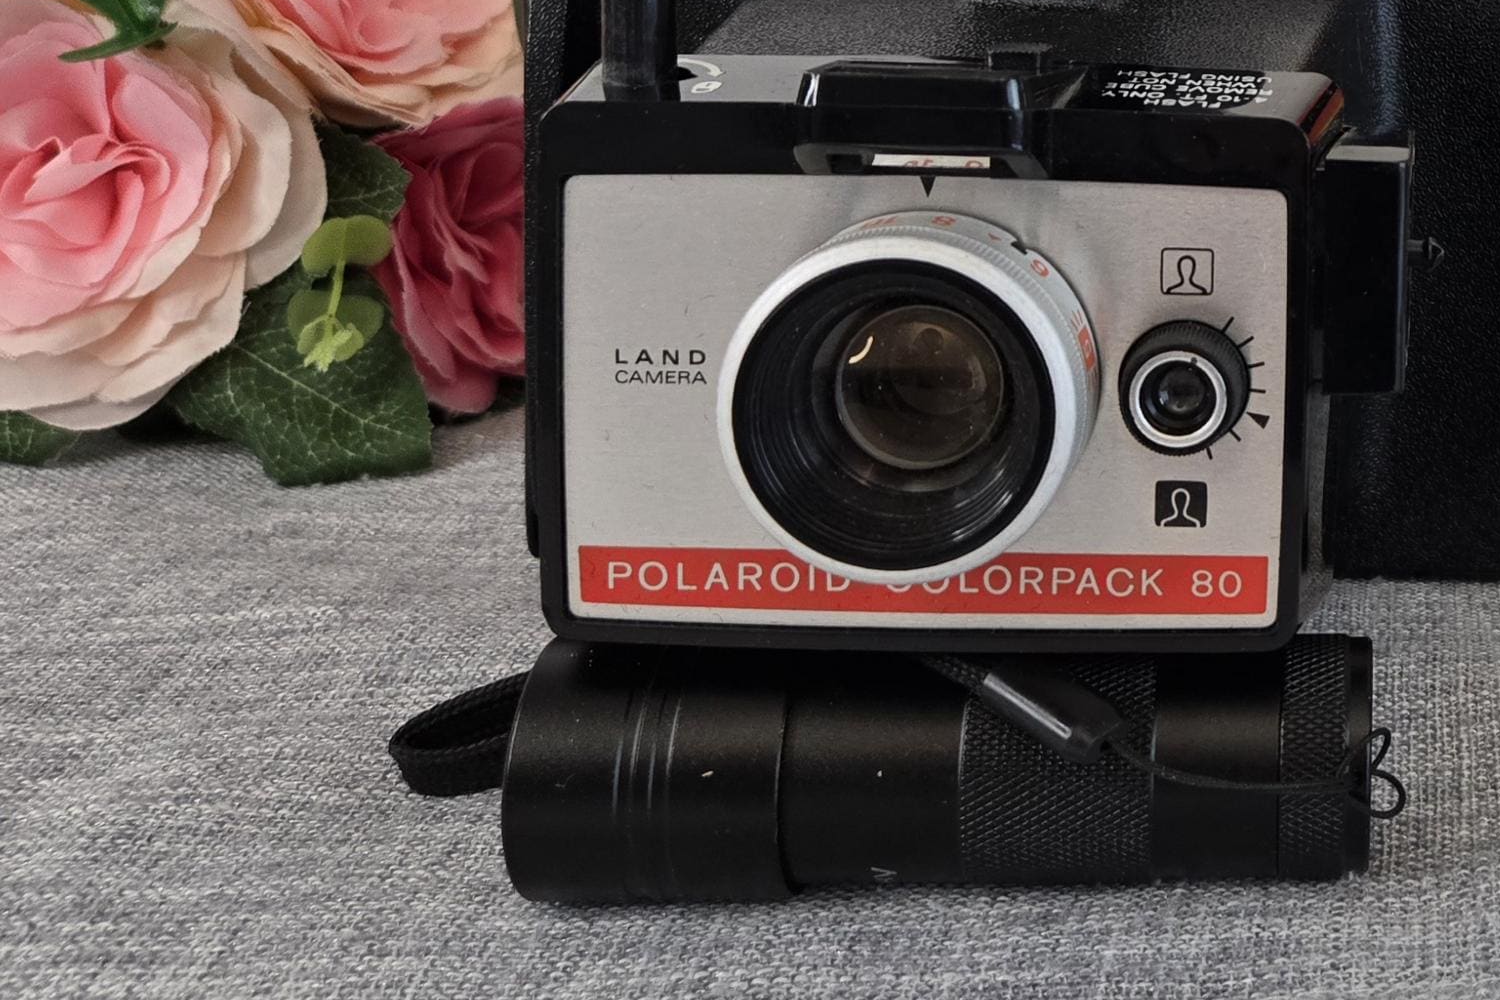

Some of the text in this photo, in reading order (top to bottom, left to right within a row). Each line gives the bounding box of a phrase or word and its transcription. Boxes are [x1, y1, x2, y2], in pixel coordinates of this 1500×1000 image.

[1117, 70, 1273, 83] USING FLASH
[1129, 77, 1256, 89] WHEN NOT
[1105, 82, 1273, 96] REMOVE CUBE
[1143, 98, 1221, 108] FLASH
[615, 348, 706, 365] LAND
[615, 370, 707, 384] CAMERA
[607, 561, 1242, 598] POLAROID LORPACK 80
